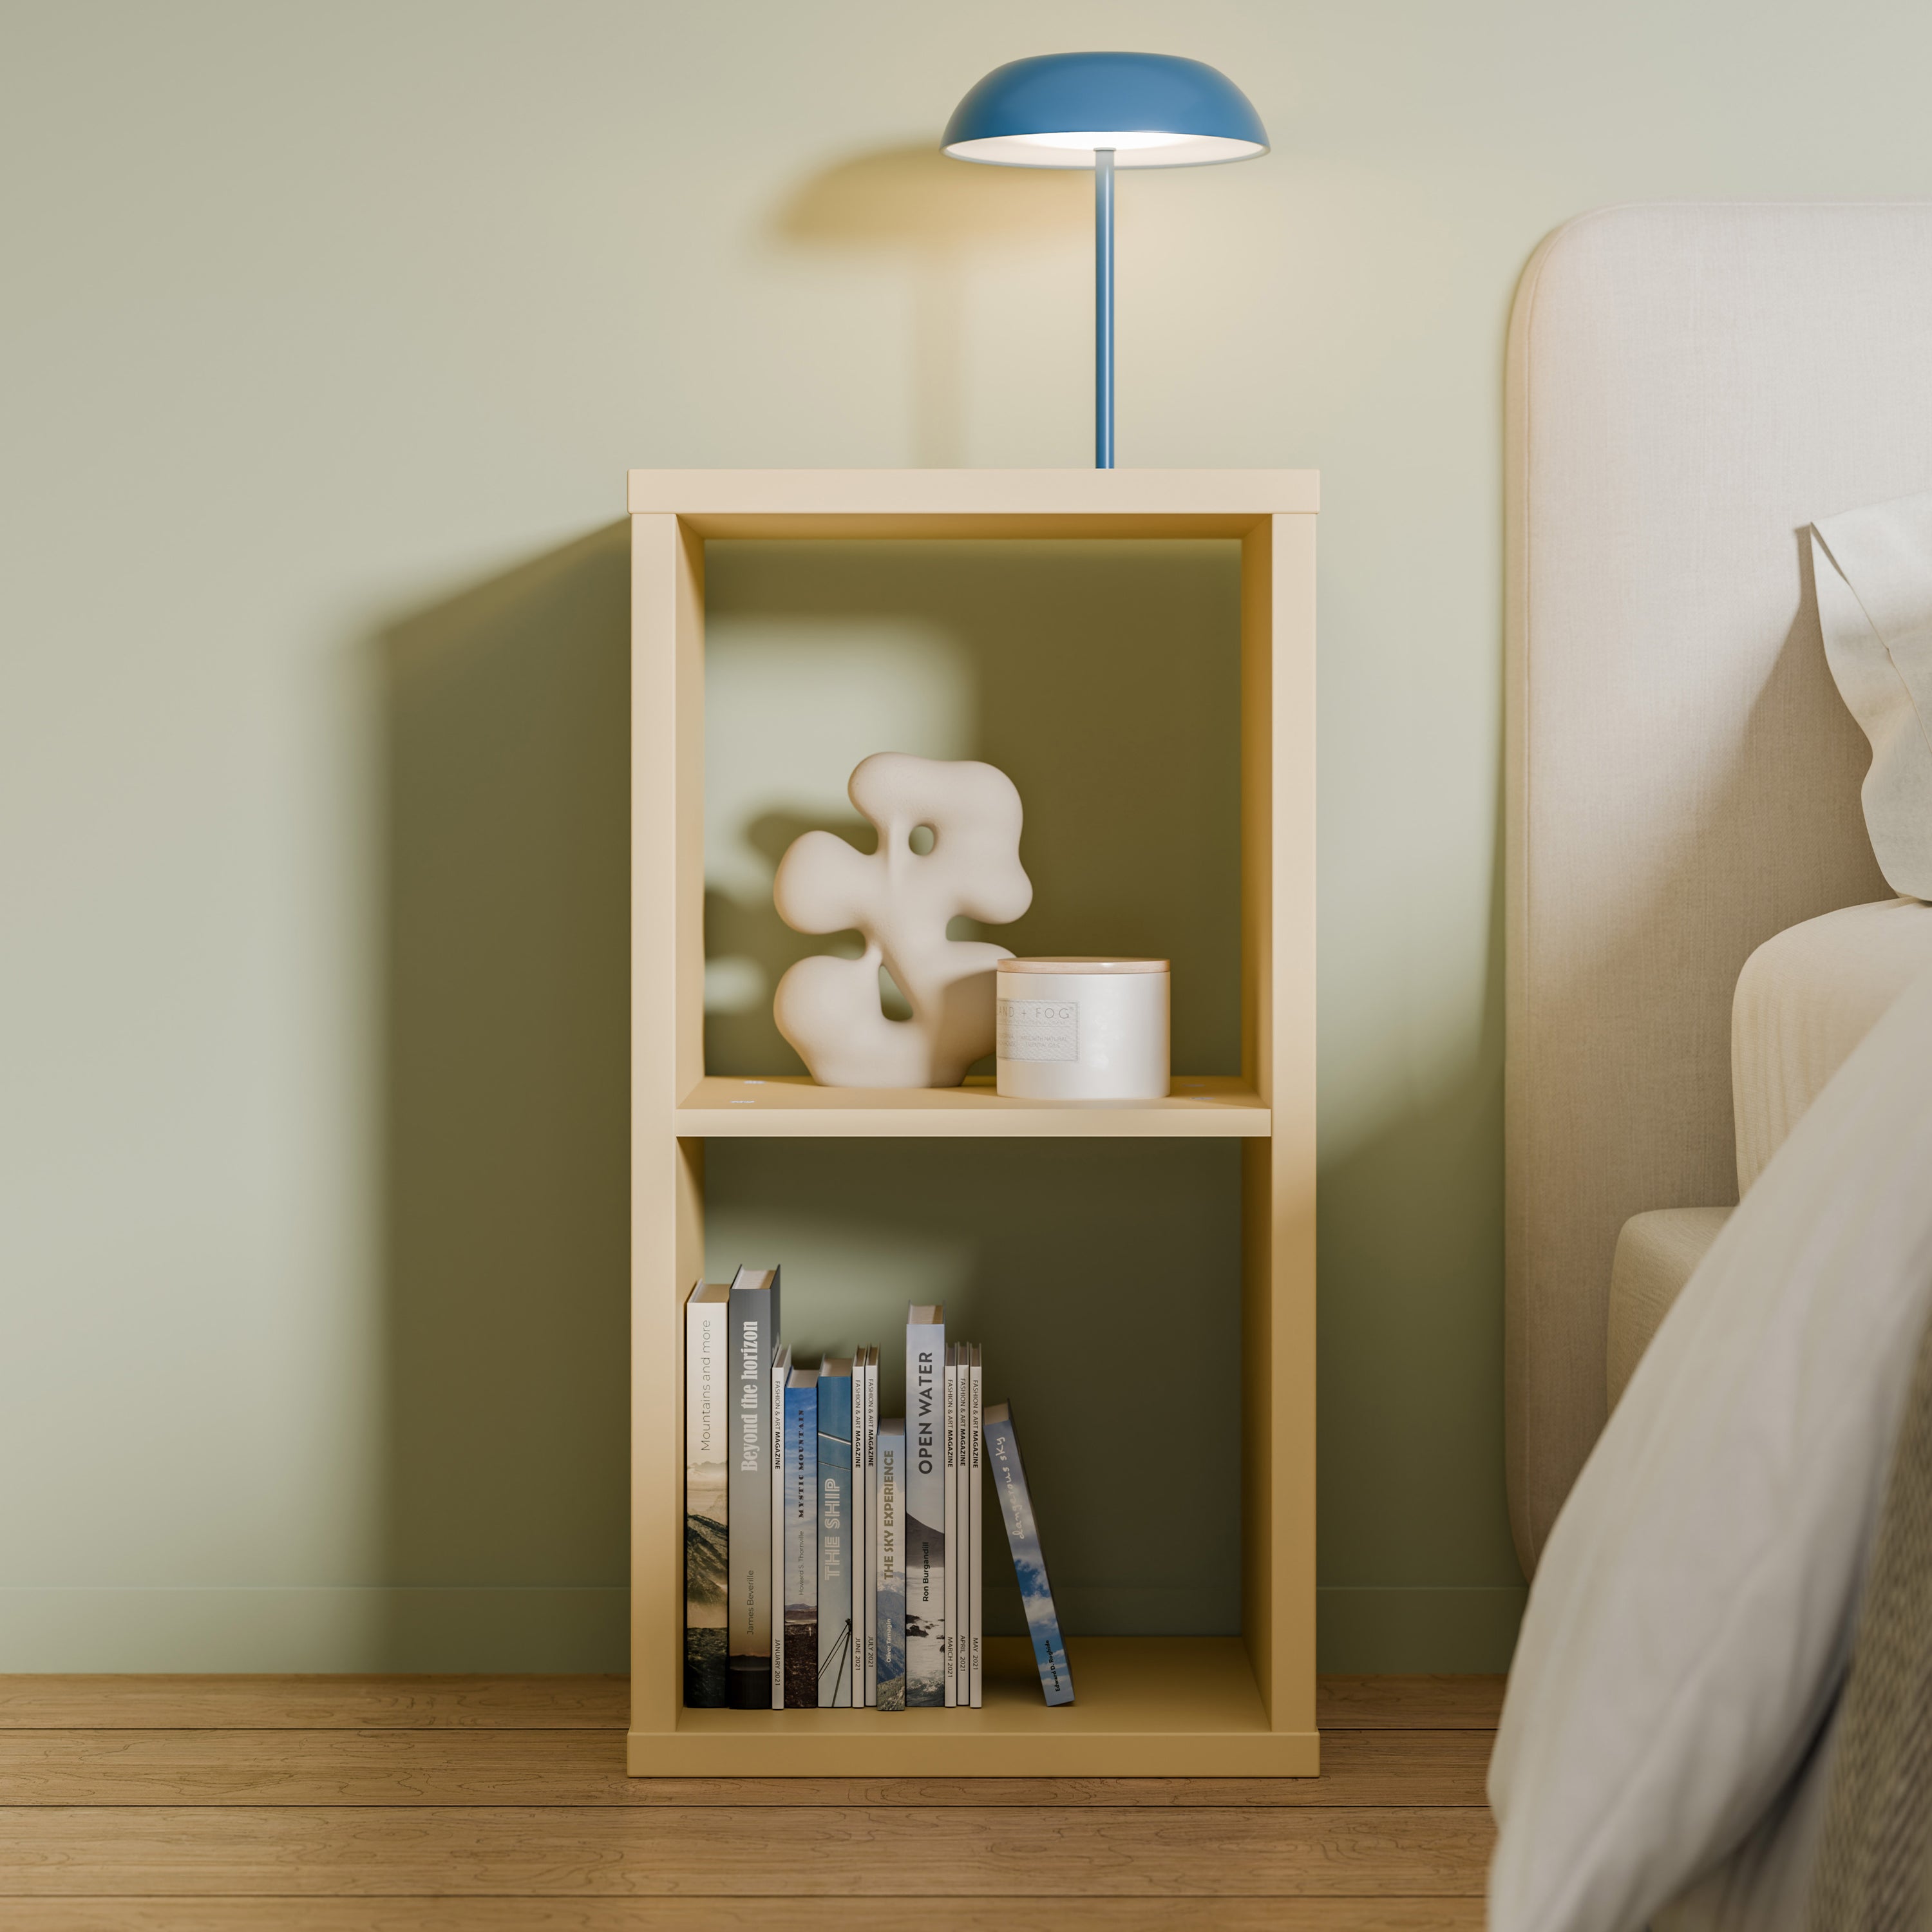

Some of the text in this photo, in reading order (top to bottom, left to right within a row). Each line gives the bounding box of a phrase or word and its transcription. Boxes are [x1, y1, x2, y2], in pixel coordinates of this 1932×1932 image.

[1021, 1009, 1027, 1018] +
[701, 1320, 710, 1450] Mountains and more
[741, 1321, 760, 1472] Beyond the horizon
[918, 1352, 933, 1474] OPEN WATER
[824, 1479, 840, 1580] THE SHIP
[884, 1450, 893, 1580] THE SKY EXPERIENCE
[1002, 1467, 1025, 1539] dangerous
[1051, 1671, 1061, 1692] Edward
